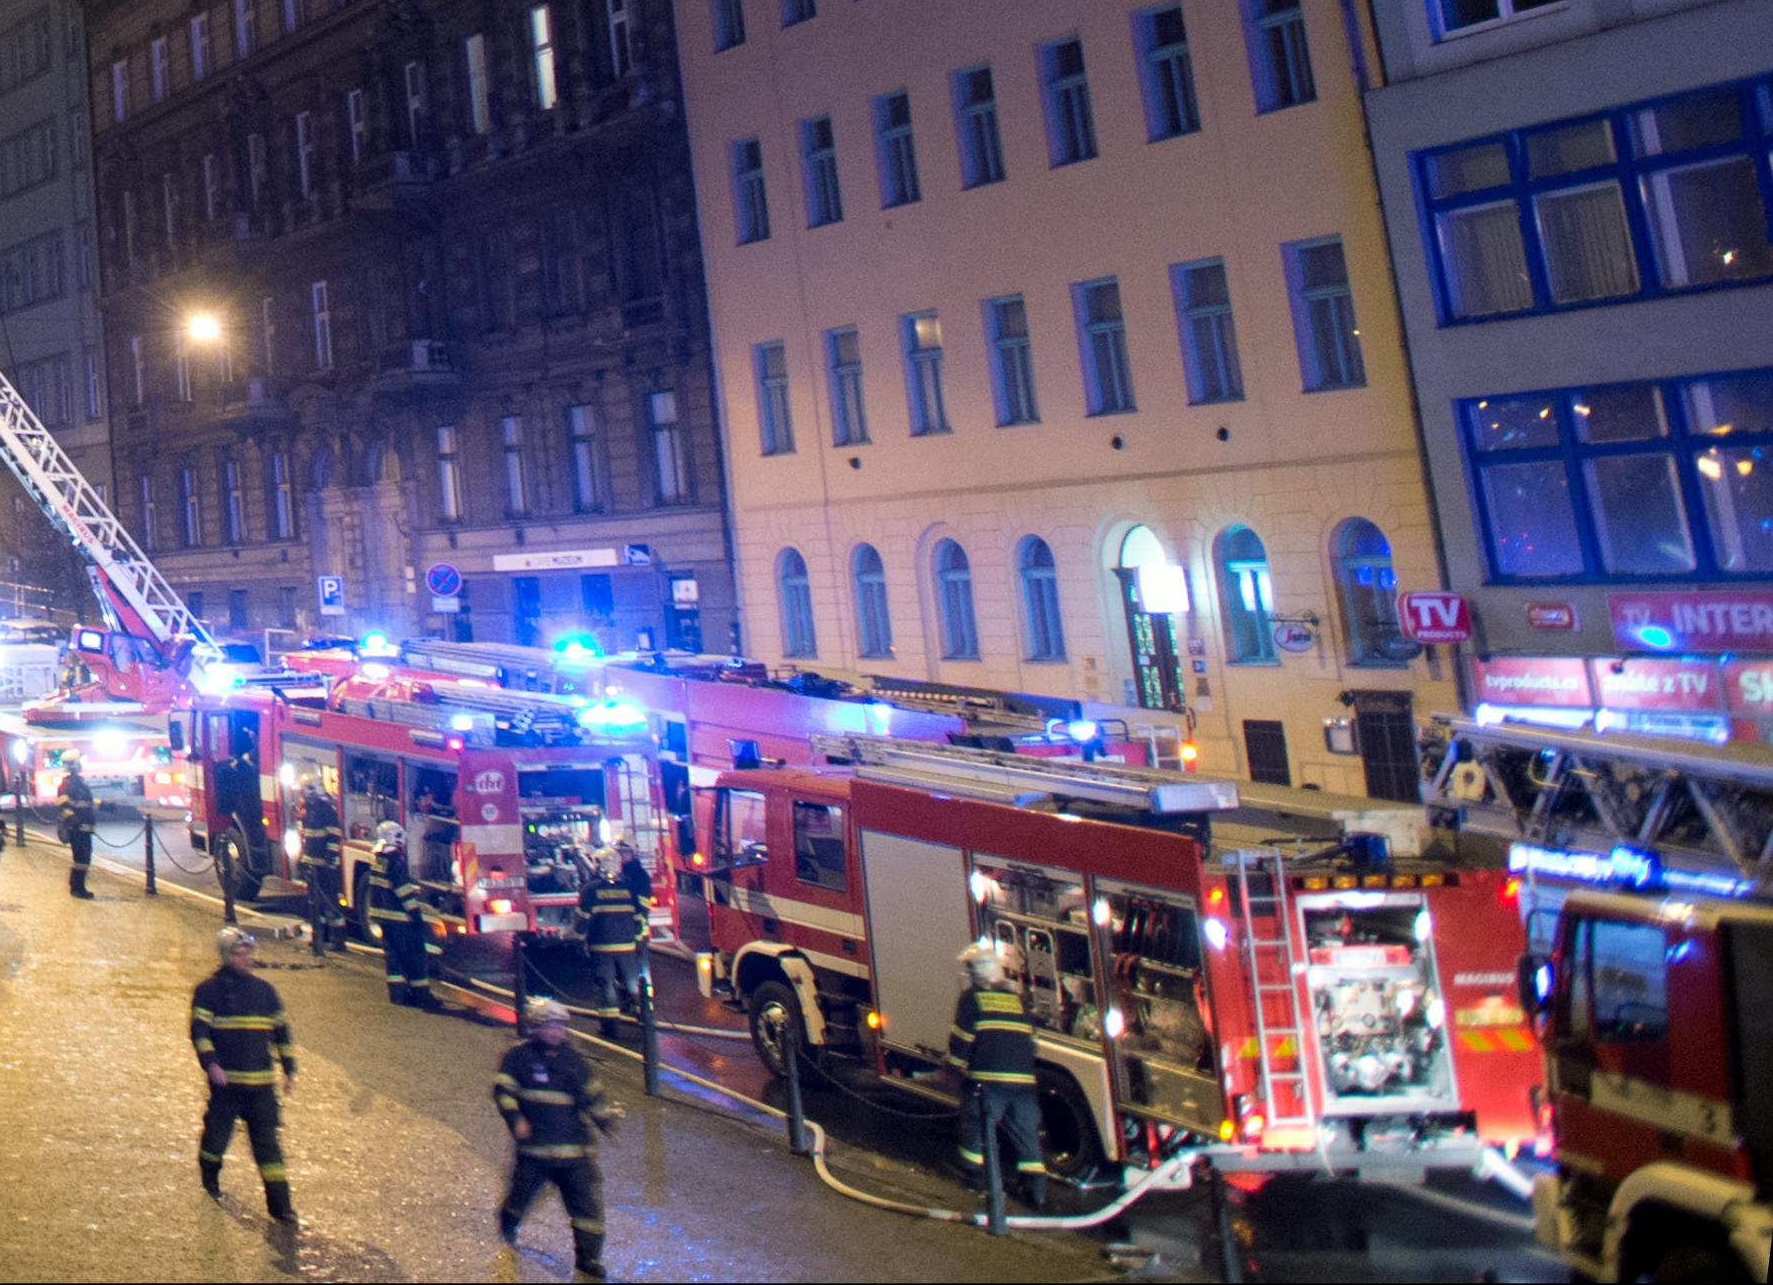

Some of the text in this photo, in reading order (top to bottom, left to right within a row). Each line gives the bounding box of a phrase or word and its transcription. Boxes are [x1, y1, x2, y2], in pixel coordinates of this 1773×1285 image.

[324, 579, 338, 599] P
[1411, 598, 1460, 627] TV
[1417, 630, 1467, 640] PRODUCTS
[1485, 672, 1578, 691] tvproducts.cz
[1663, 676, 1675, 694] z
[1677, 671, 1707, 694] TV
[1452, 971, 1516, 987] MAGIRUS
